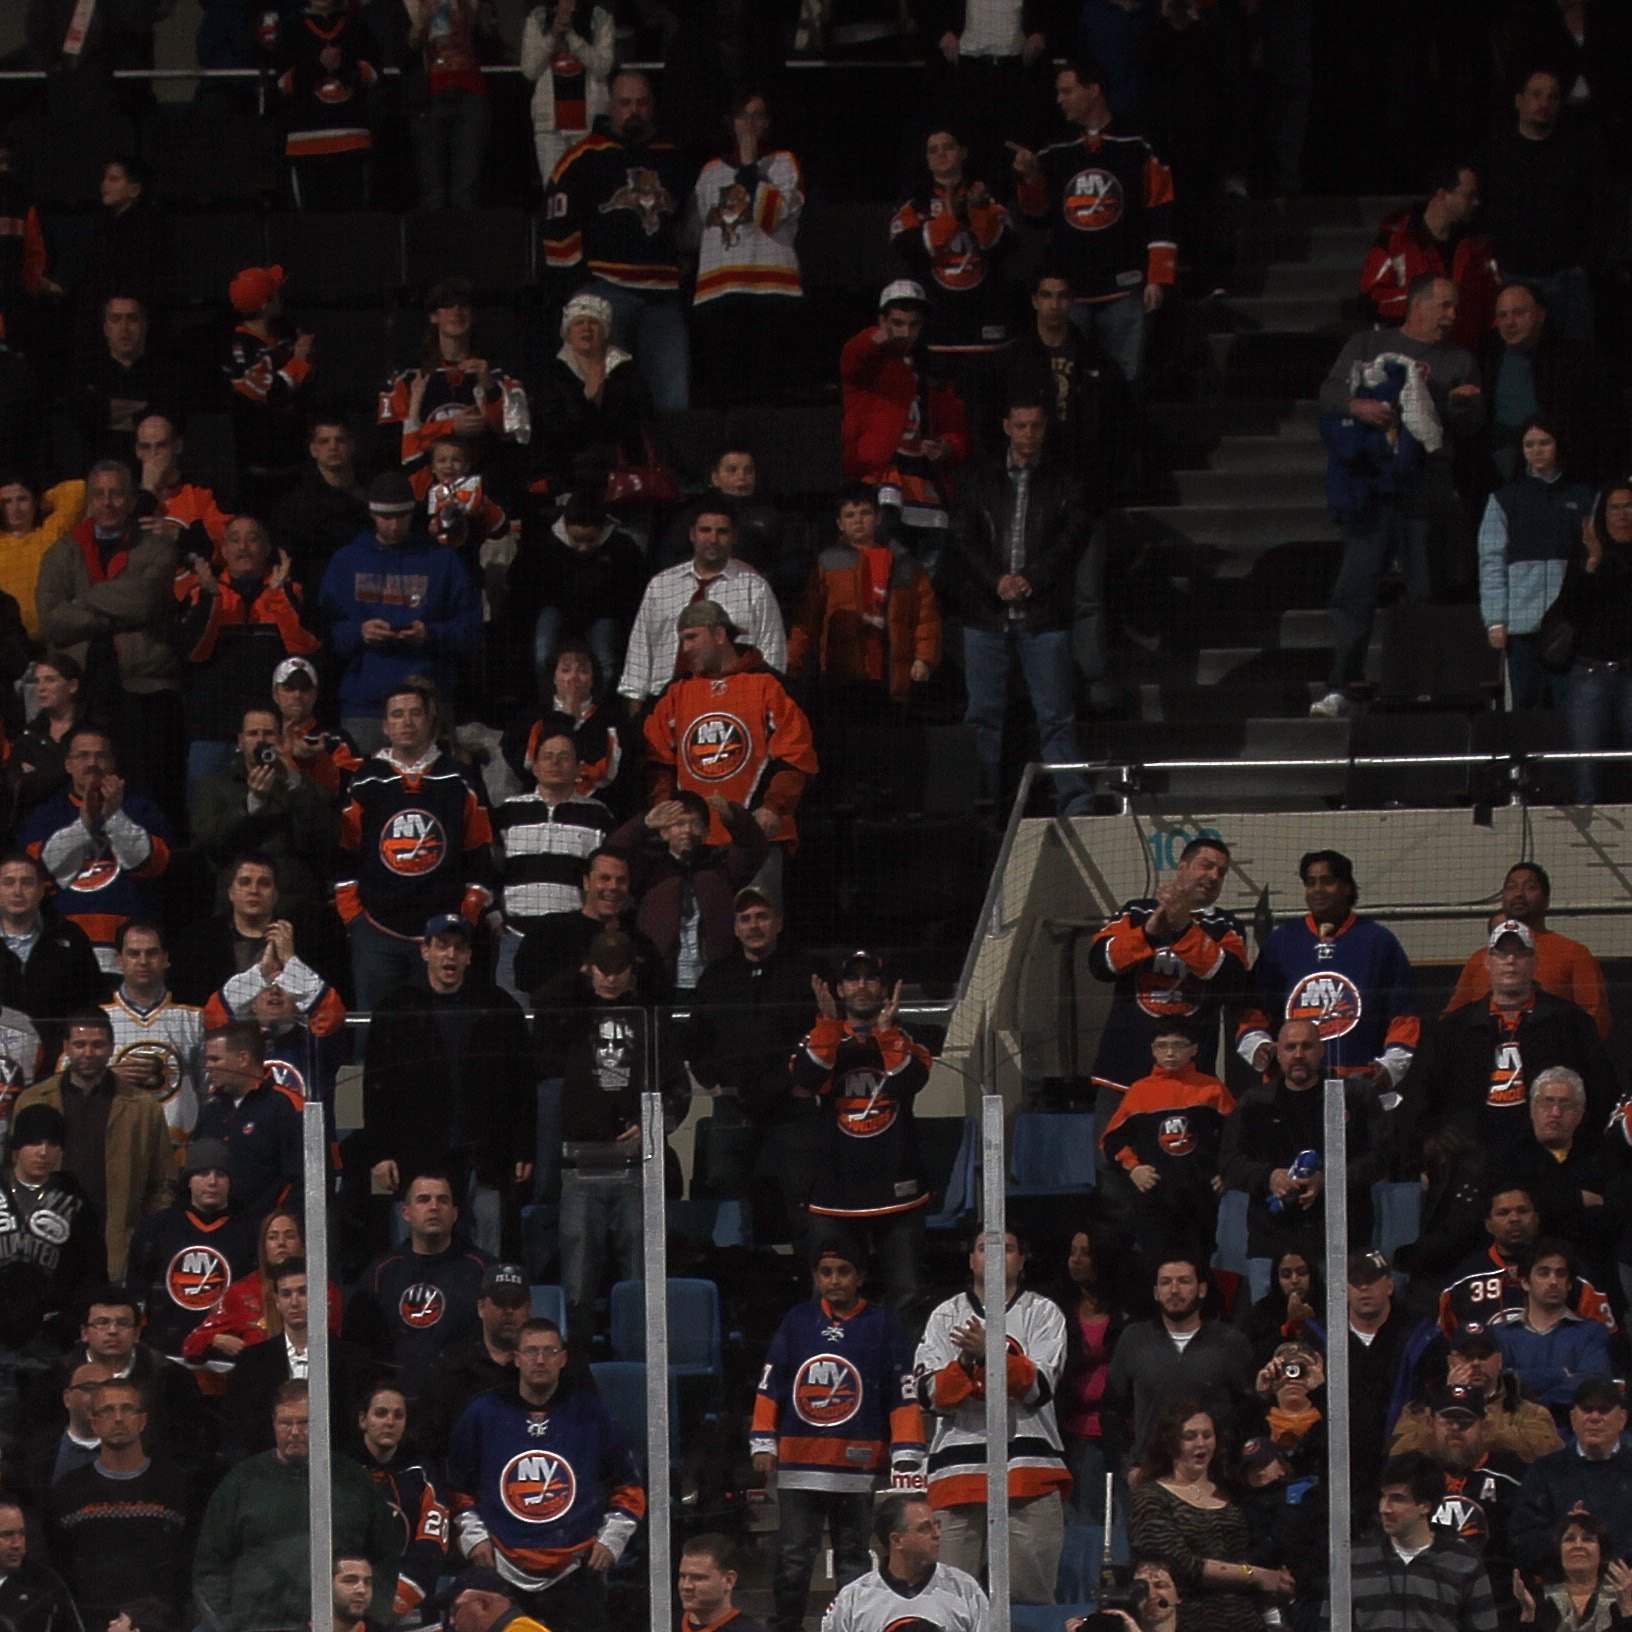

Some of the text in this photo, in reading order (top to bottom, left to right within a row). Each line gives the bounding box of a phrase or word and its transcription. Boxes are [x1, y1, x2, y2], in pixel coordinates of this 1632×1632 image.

[1076, 174, 1114, 197] NY
[697, 721, 736, 745] NY
[393, 814, 434, 839] NY
[1301, 978, 1345, 1007] NY
[181, 1251, 220, 1274] NY
[1470, 1278, 1502, 1302] 39
[808, 1360, 849, 1385] NY
[518, 1456, 559, 1482] NY
[1480, 1477, 1497, 1502] A
